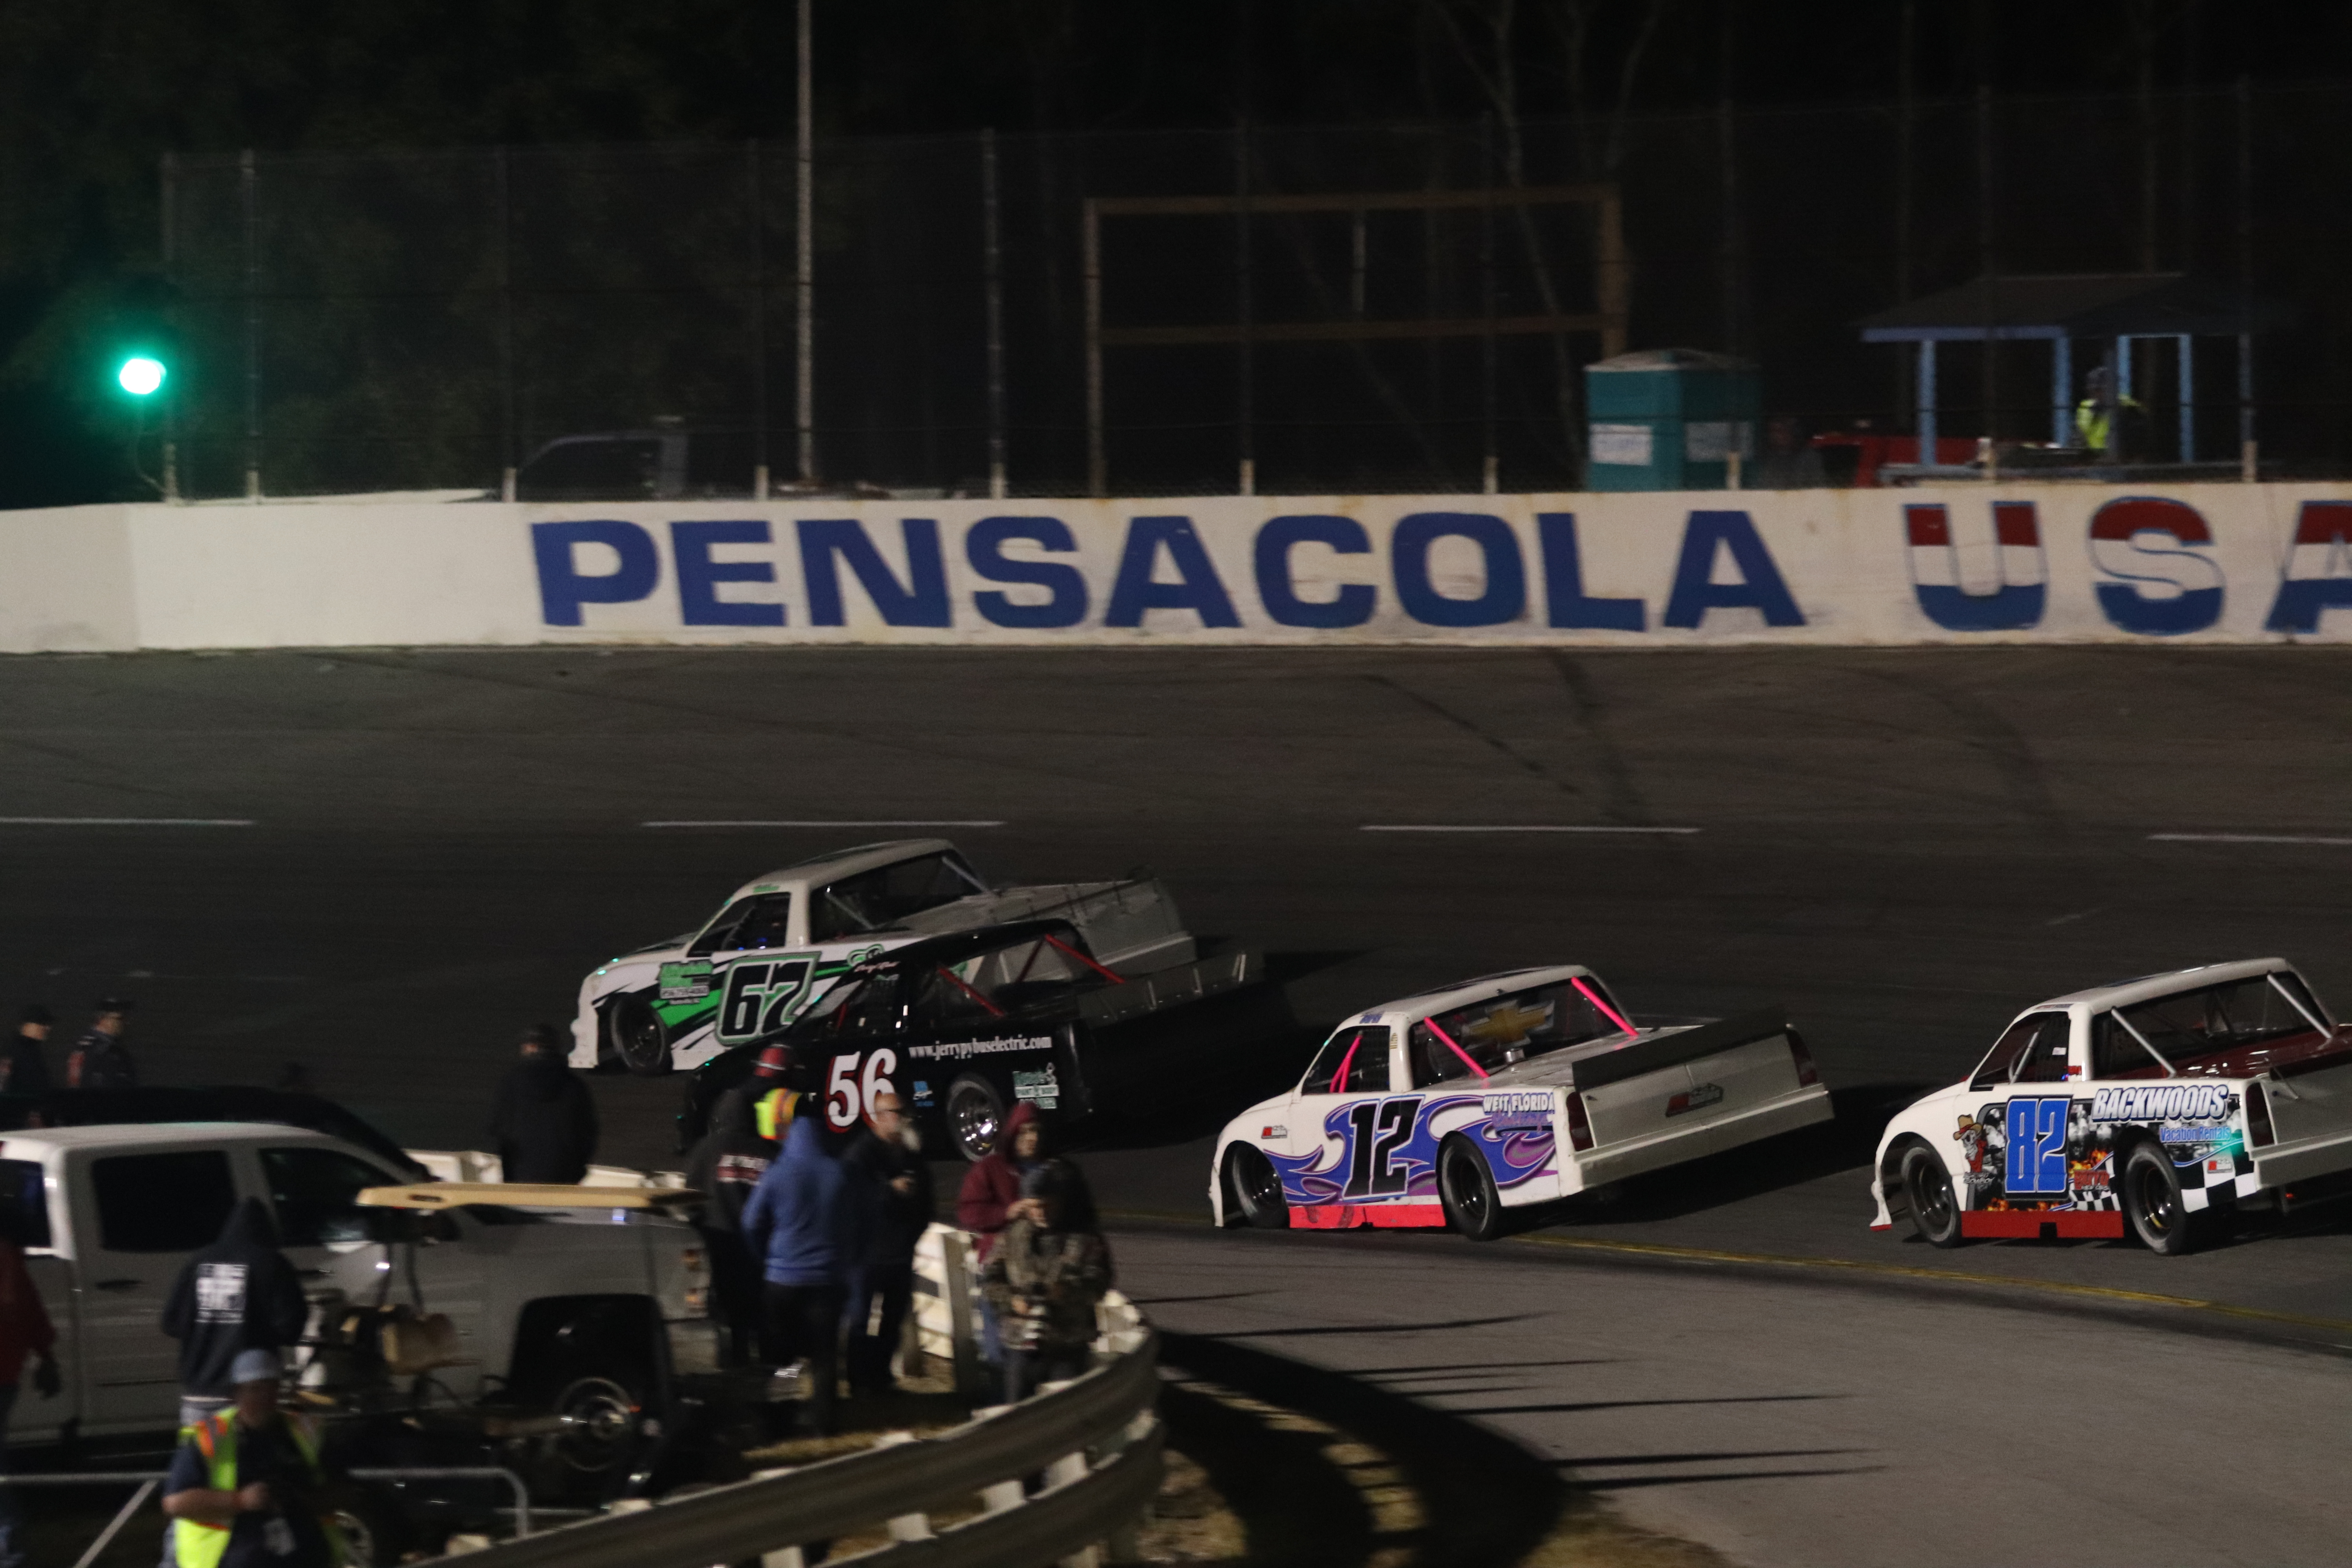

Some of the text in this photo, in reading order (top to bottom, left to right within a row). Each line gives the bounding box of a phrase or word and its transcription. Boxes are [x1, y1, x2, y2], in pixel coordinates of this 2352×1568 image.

[531, 496, 2352, 636] PENSACOLA USA
[717, 958, 817, 1041] 67
[826, 1047, 897, 1132] 56
[2092, 1085, 2229, 1122] BACKWOODS
[1342, 1095, 1425, 1200] 12
[2004, 1096, 2072, 1193] 82
[2160, 1125, 2231, 1142] Vacation Rentals
